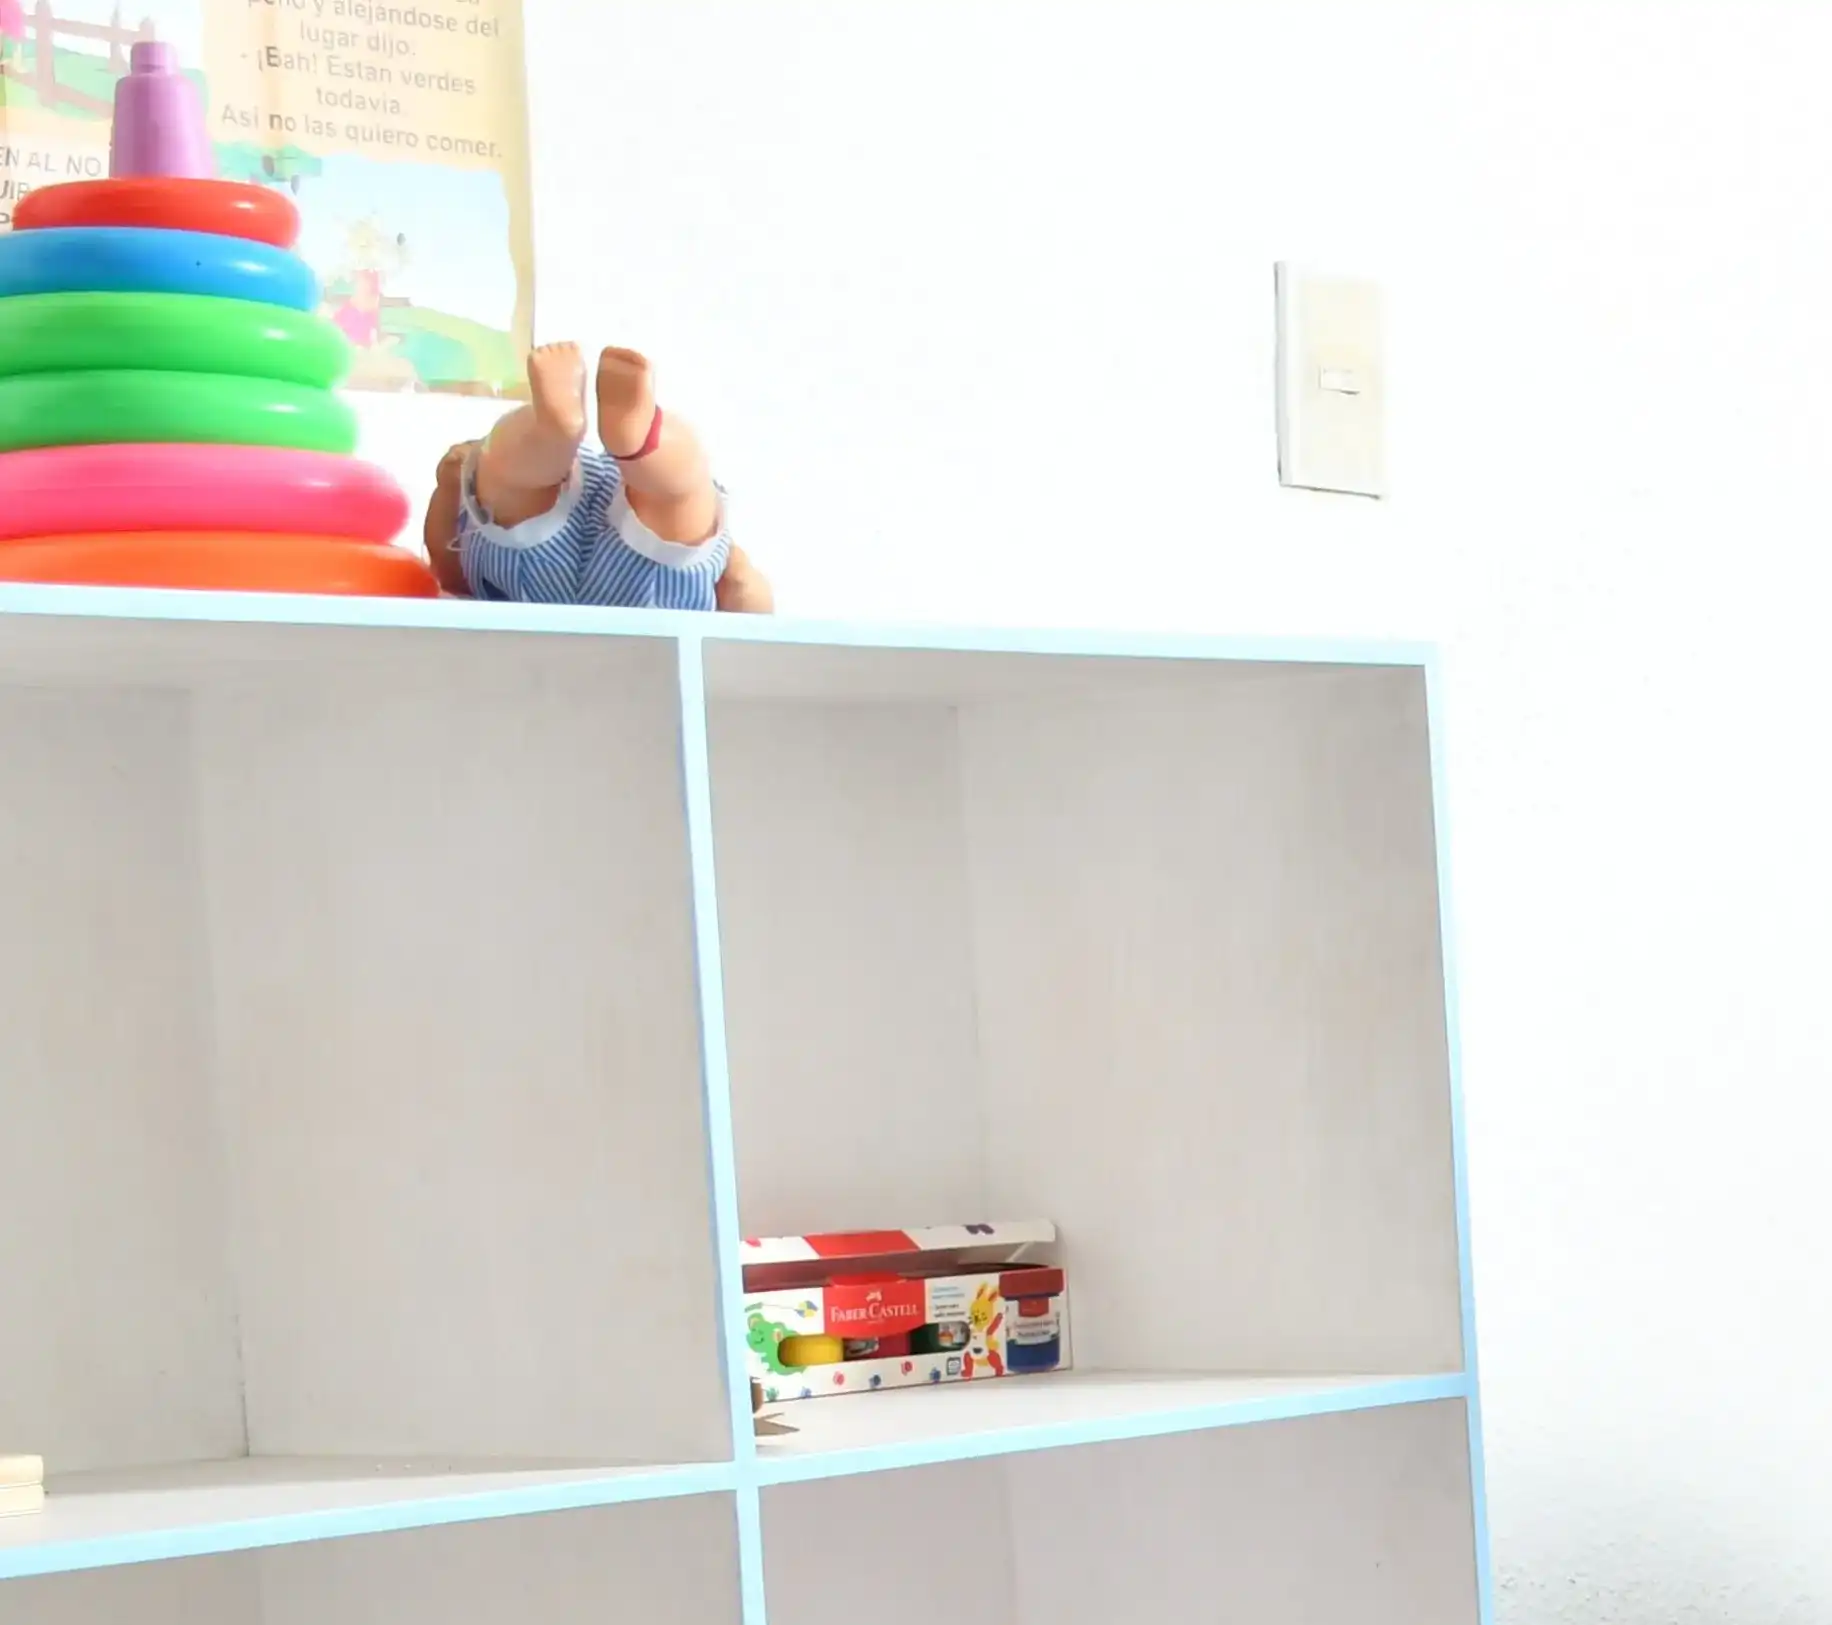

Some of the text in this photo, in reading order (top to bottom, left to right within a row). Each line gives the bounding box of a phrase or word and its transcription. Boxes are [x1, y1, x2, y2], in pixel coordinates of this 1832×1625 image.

[299, 21, 416, 58] lugar dijo.
[466, 18, 499, 37] del
[400, 70, 477, 95] verdes
[268, 113, 297, 132] no
[304, 114, 337, 138] las
[345, 123, 419, 148] quiero
[425, 134, 503, 159] comer.
[27, 152, 57, 173] AL
[66, 154, 102, 178] NO
